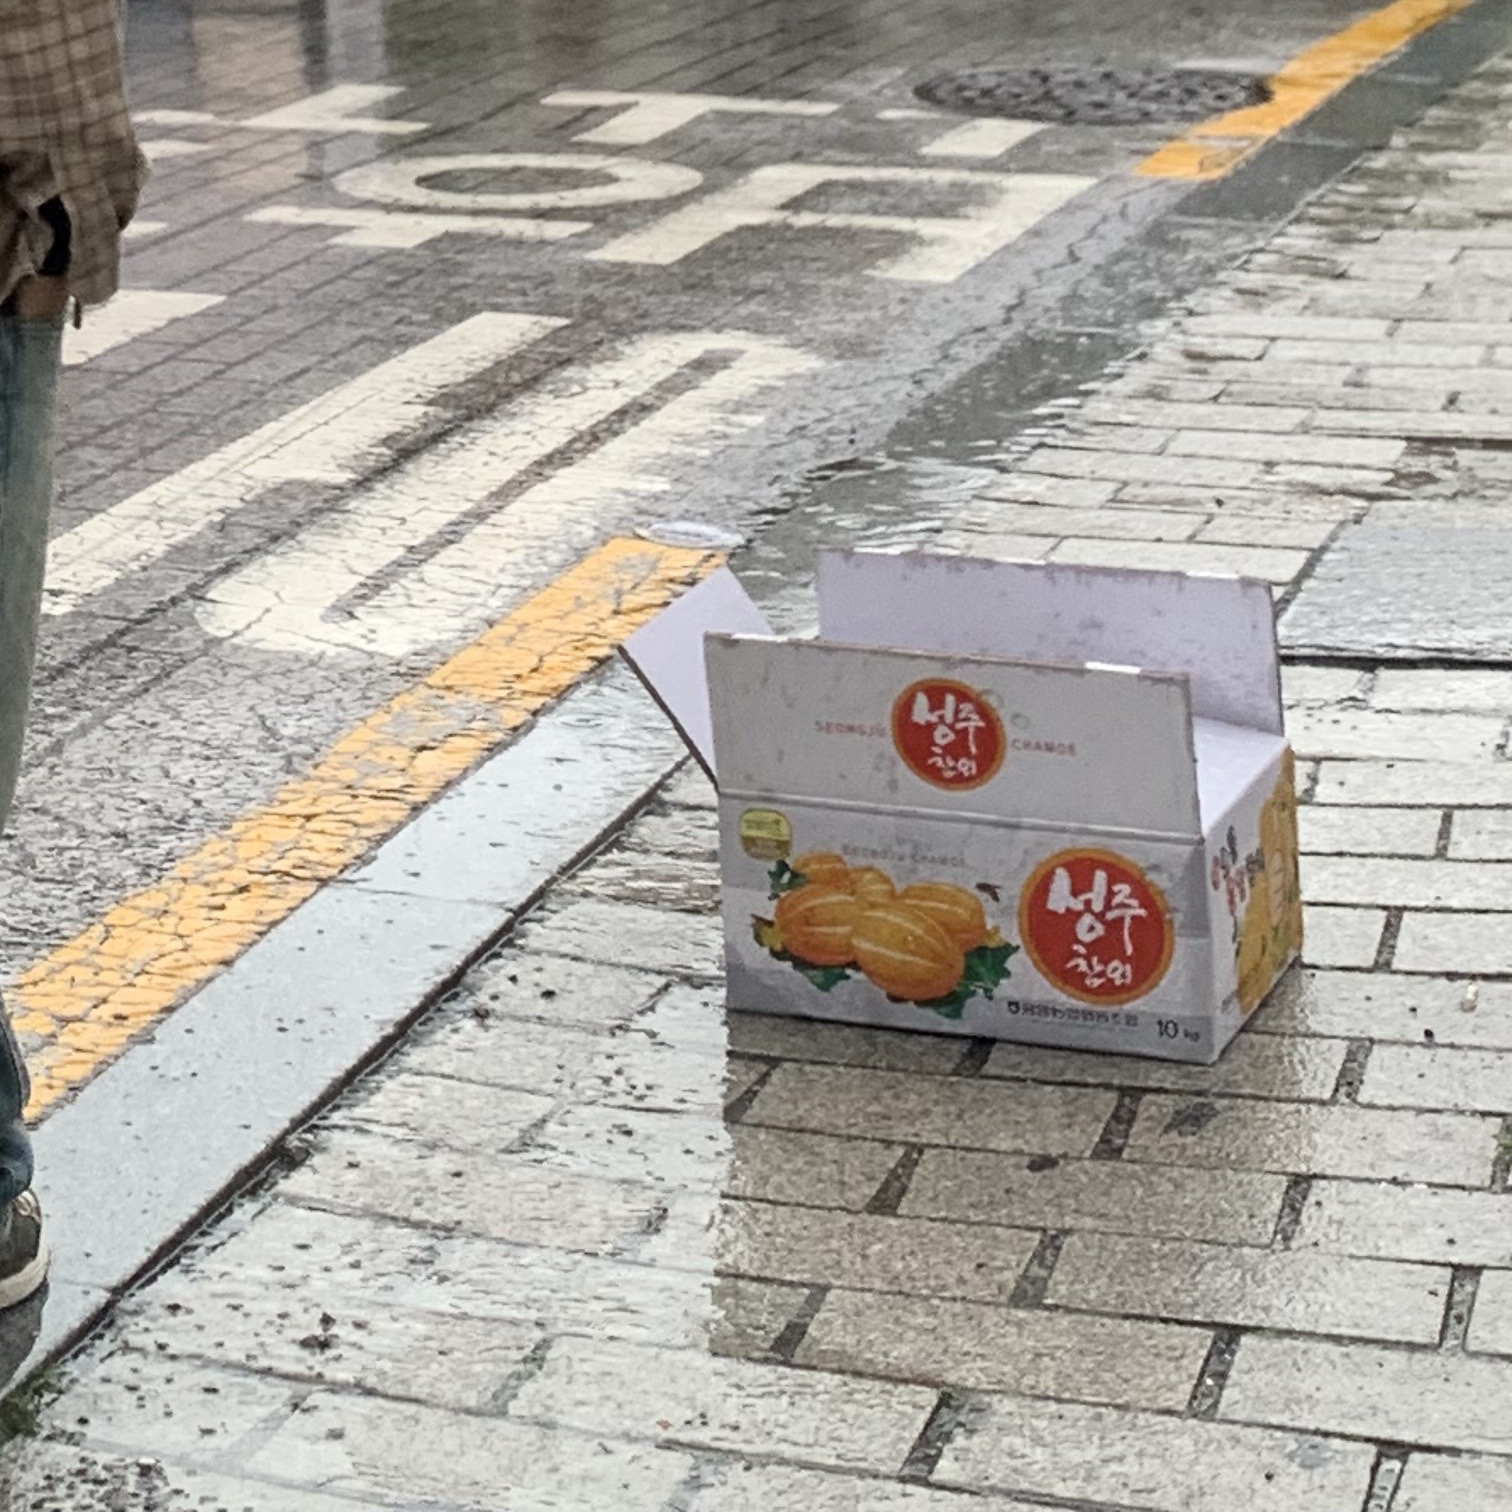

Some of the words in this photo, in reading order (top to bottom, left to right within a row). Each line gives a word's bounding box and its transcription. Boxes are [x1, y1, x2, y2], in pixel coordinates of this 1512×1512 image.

[814, 720, 886, 737] SEONGJU
[911, 691, 986, 755] 성주
[927, 745, 977, 779] 참외
[1046, 866, 1148, 956] 성주
[1065, 944, 1133, 988] 참외
[1156, 1019, 1179, 1039] 10
